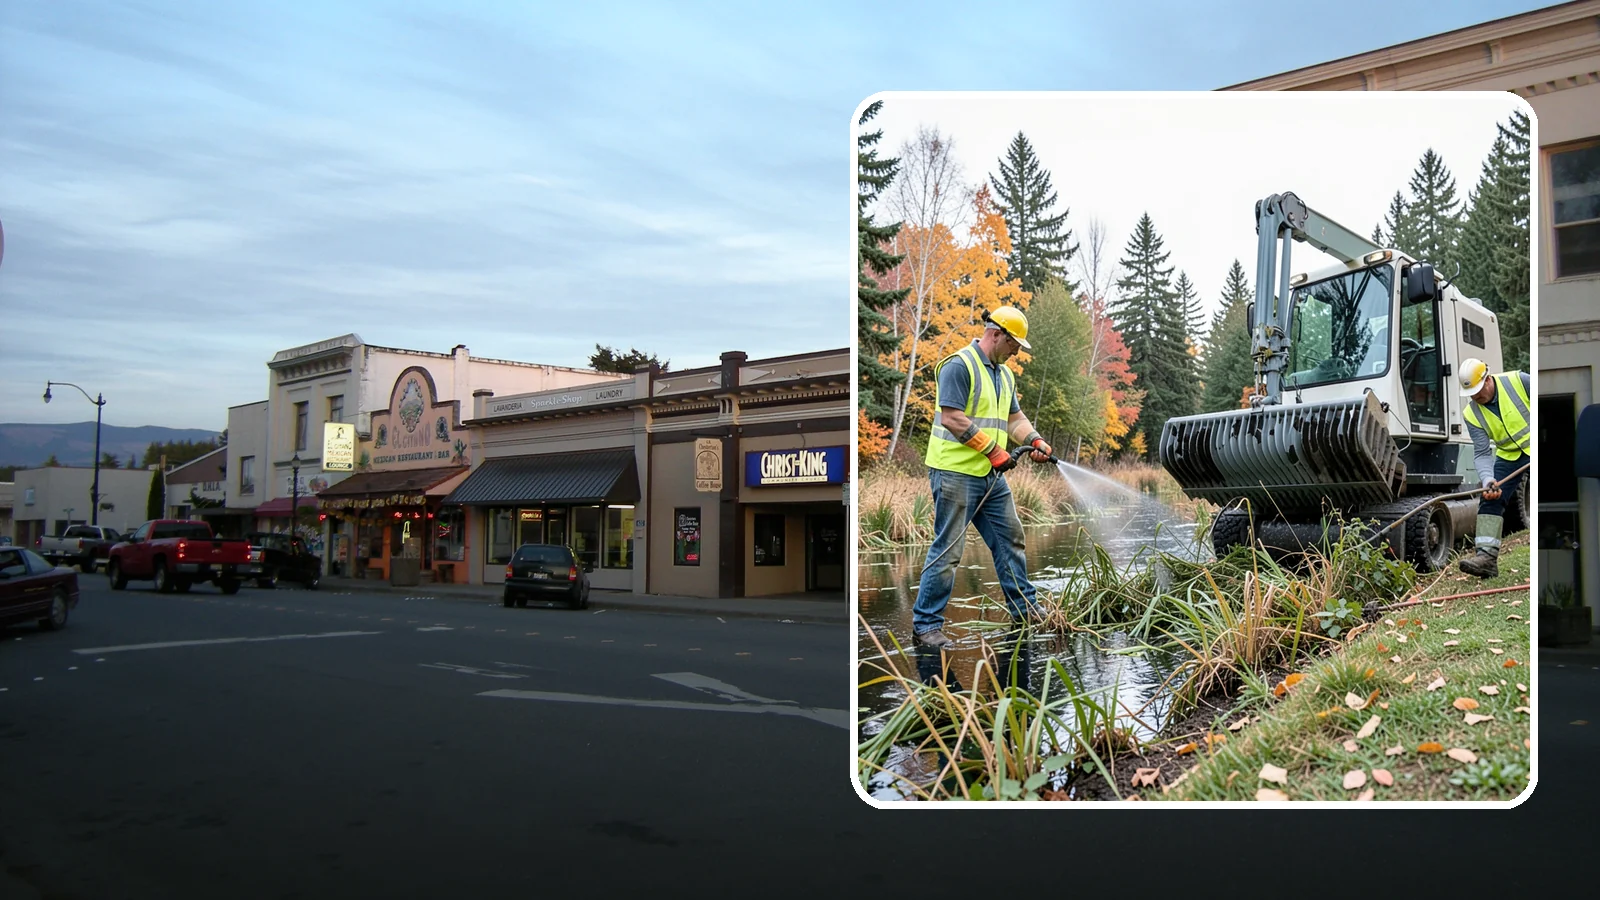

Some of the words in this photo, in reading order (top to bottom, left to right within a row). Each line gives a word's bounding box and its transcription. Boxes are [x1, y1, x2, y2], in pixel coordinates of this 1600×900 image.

[530, 396, 562, 409] Sparkle
[561, 394, 582, 405] Shop
[595, 389, 623, 400] LAUNDRY
[493, 402, 522, 412] LAVANDERIA
[373, 454, 396, 464] MEXICAN
[397, 451, 433, 462] RESTAURANT
[437, 450, 450, 459] BAR
[761, 452, 797, 478] CHRIST
[799, 450, 827, 476] KING
